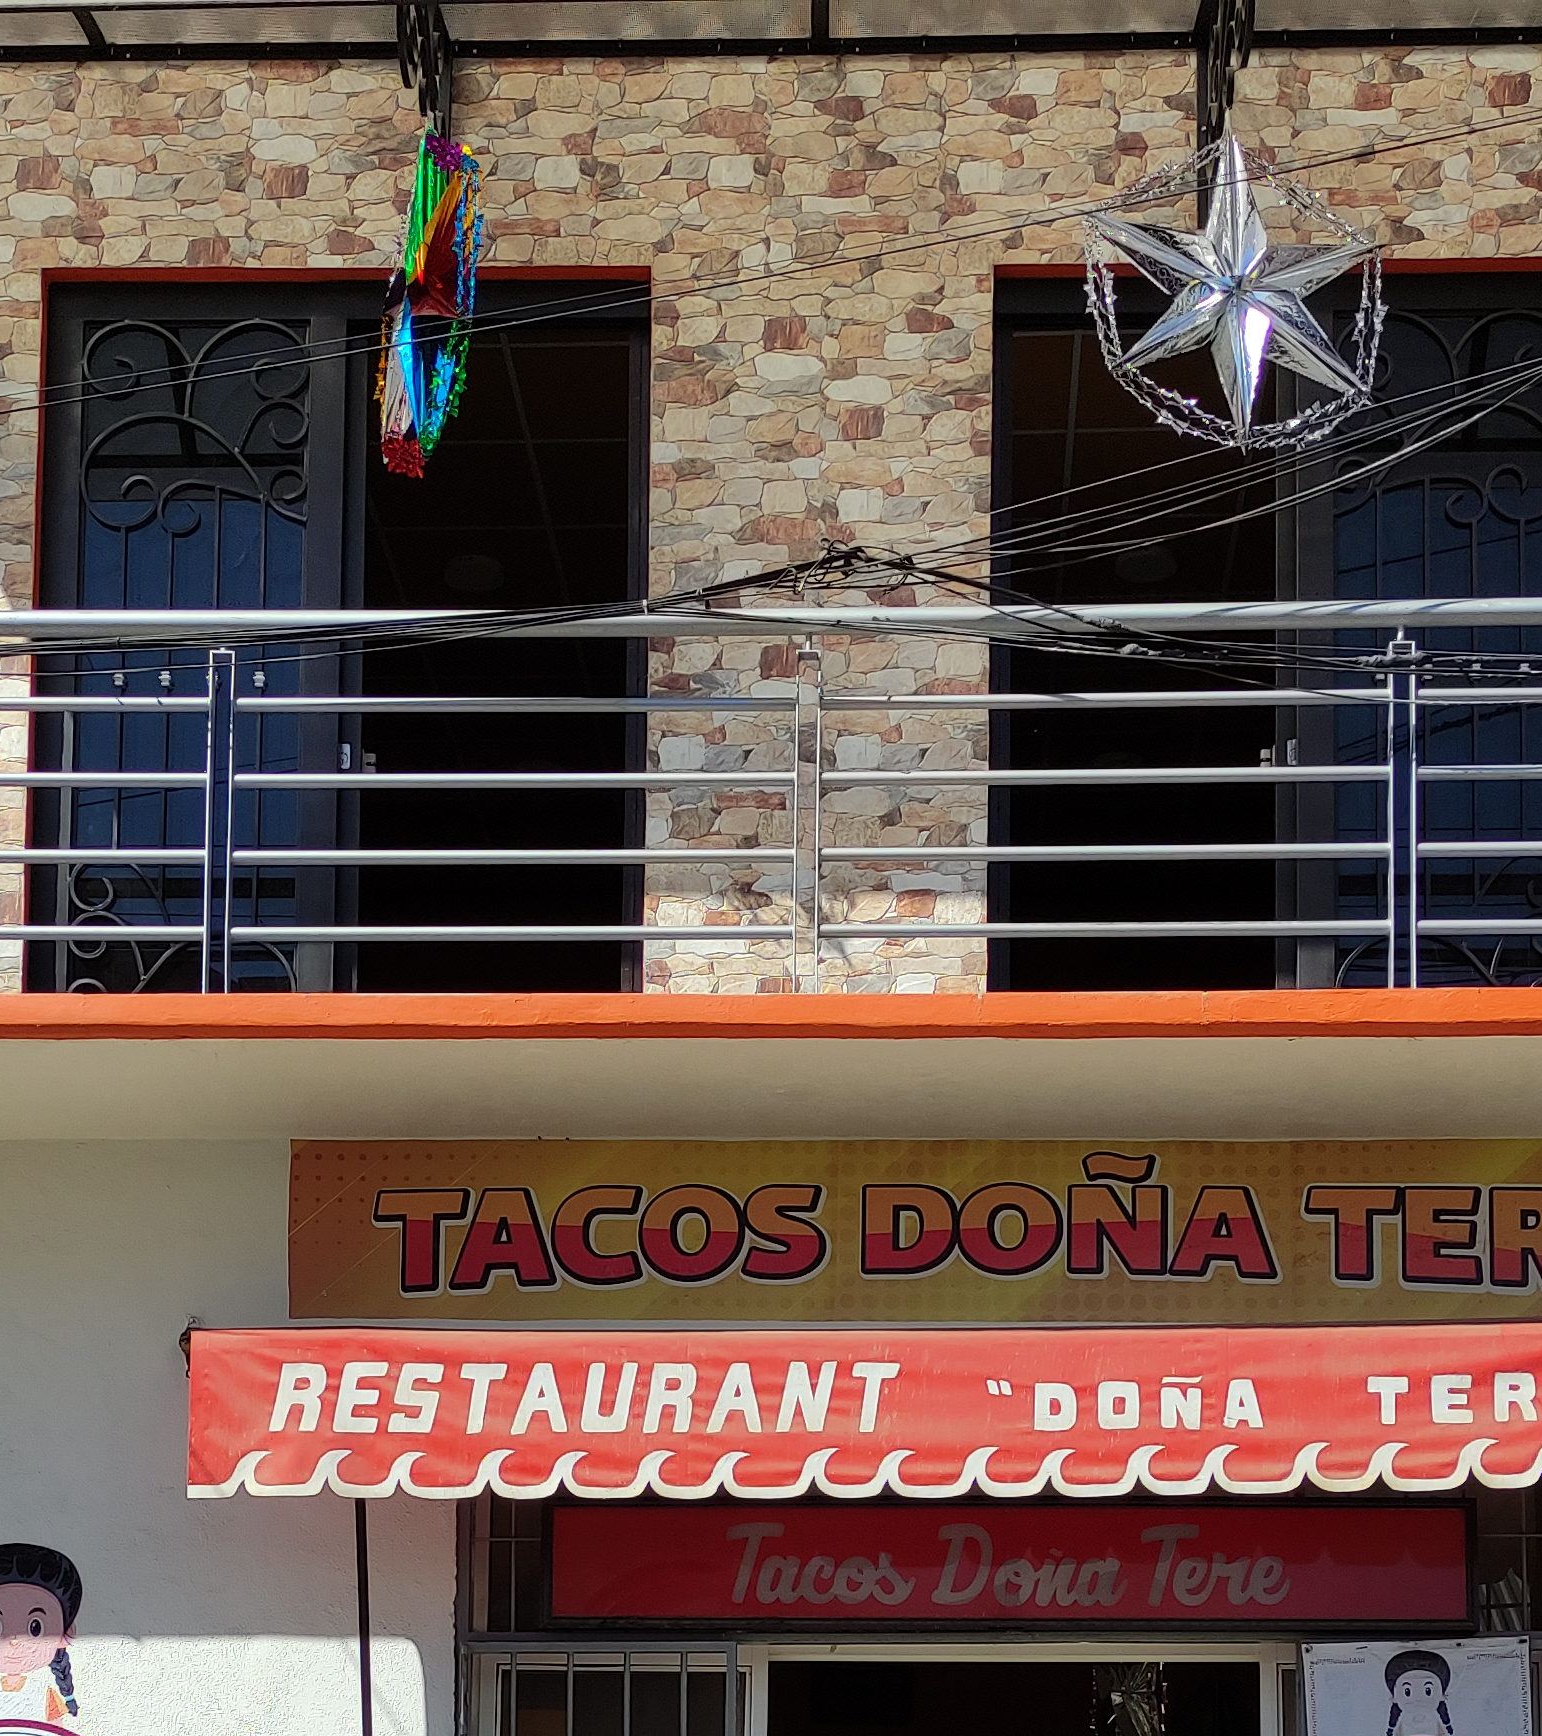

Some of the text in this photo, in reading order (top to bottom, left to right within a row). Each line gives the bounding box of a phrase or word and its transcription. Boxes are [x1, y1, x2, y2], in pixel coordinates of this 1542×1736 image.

[373, 1184, 829, 1295] TACOS
[859, 1151, 1281, 1284] DOÑA
[269, 1361, 900, 1436] RESTAURANT
[727, 1522, 916, 1606] Tacos
[1141, 1523, 1291, 1607] Tere
